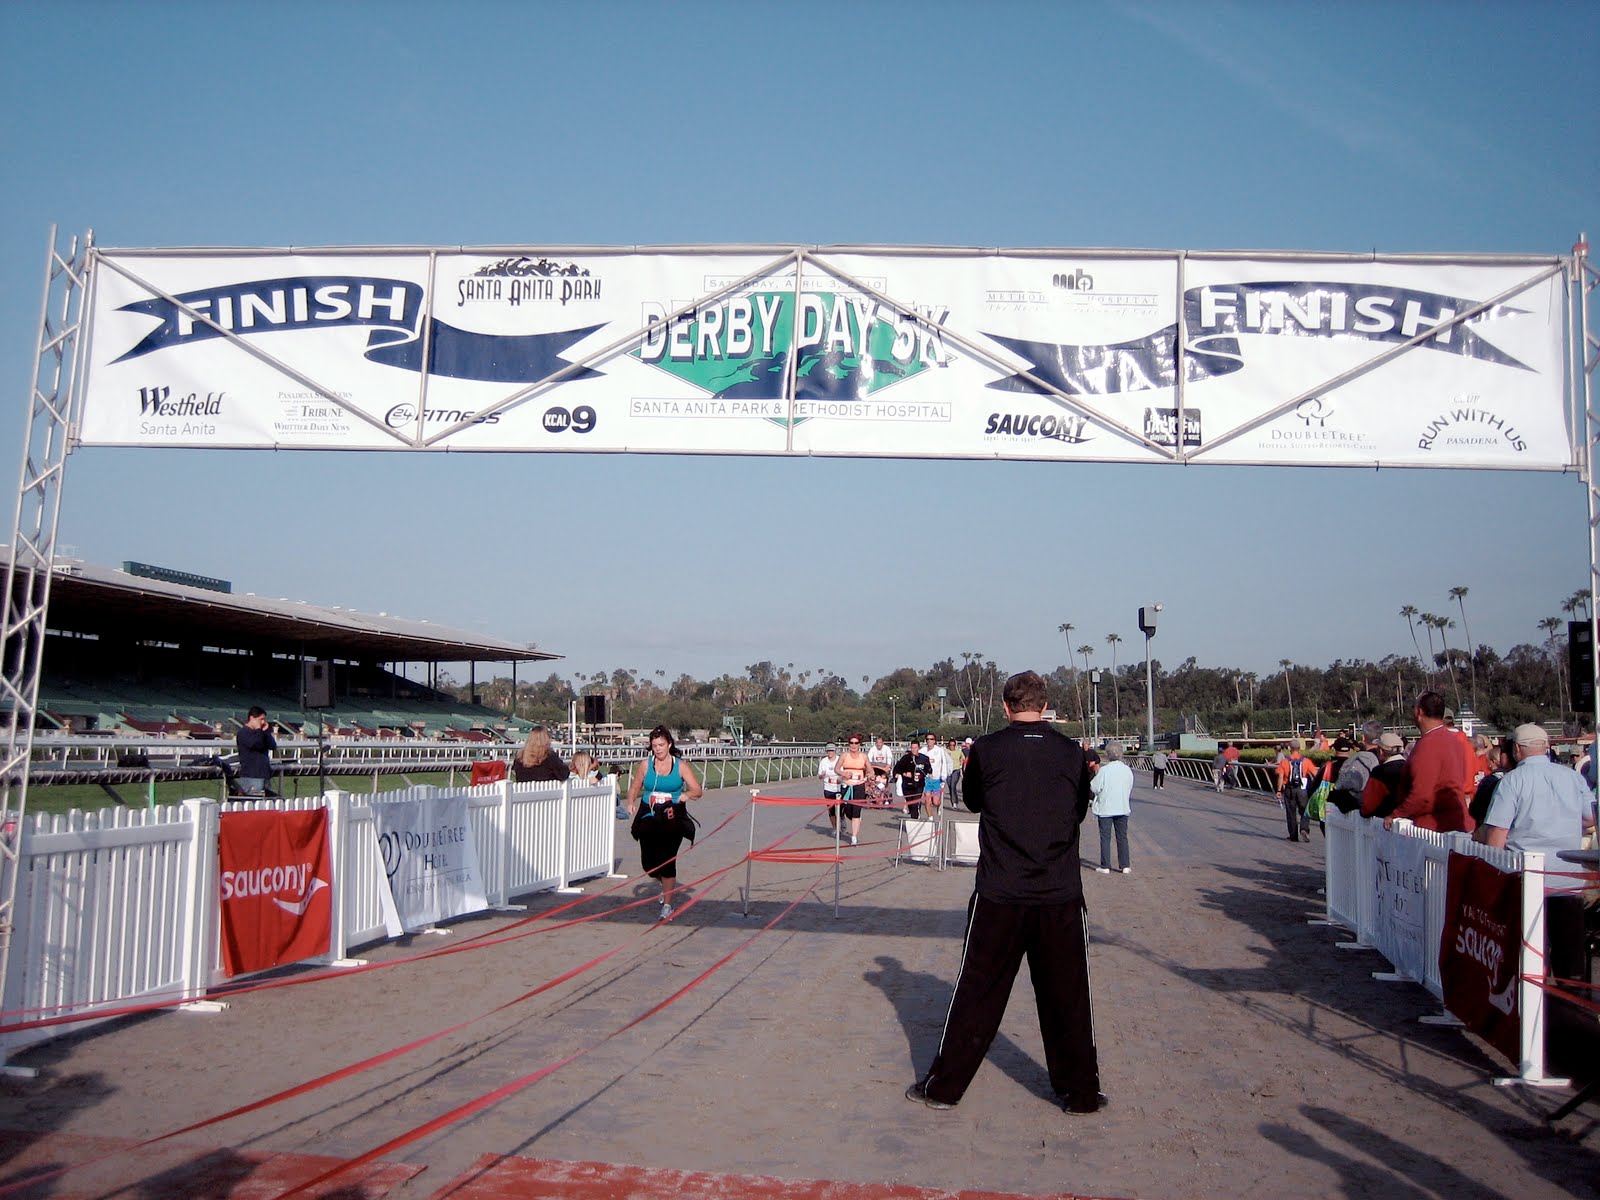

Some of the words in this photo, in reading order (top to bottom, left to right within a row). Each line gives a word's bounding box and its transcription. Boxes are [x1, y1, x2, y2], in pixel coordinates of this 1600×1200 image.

[457, 279, 501, 307] SANTA
[507, 279, 553, 306] ANITA
[559, 279, 601, 306] PARK
[785, 279, 823, 288] ARIL
[178, 284, 407, 336] FINISH
[1201, 290, 1455, 343] FINISH
[640, 295, 784, 362] DERBY
[796, 293, 879, 359] DAY
[891, 301, 949, 366] 5K
[137, 386, 226, 416] Westfield
[301, 405, 344, 417] TRIBUNE
[393, 408, 413, 421] 24
[633, 402, 679, 413] SANTA
[685, 402, 726, 414] ANITA
[732, 403, 769, 414] PARK
[773, 403, 782, 414] &
[877, 405, 948, 418] HOSPITAL
[140, 422, 177, 435] Santa
[181, 422, 216, 435] Anita
[544, 413, 568, 427] KCAL
[571, 405, 597, 434] 9
[984, 413, 1090, 437] SAUCONY
[1418, 415, 1449, 450] RUN
[1450, 408, 1504, 430] WITH
[1504, 427, 1527, 451] US
[222, 863, 307, 900] saucony
